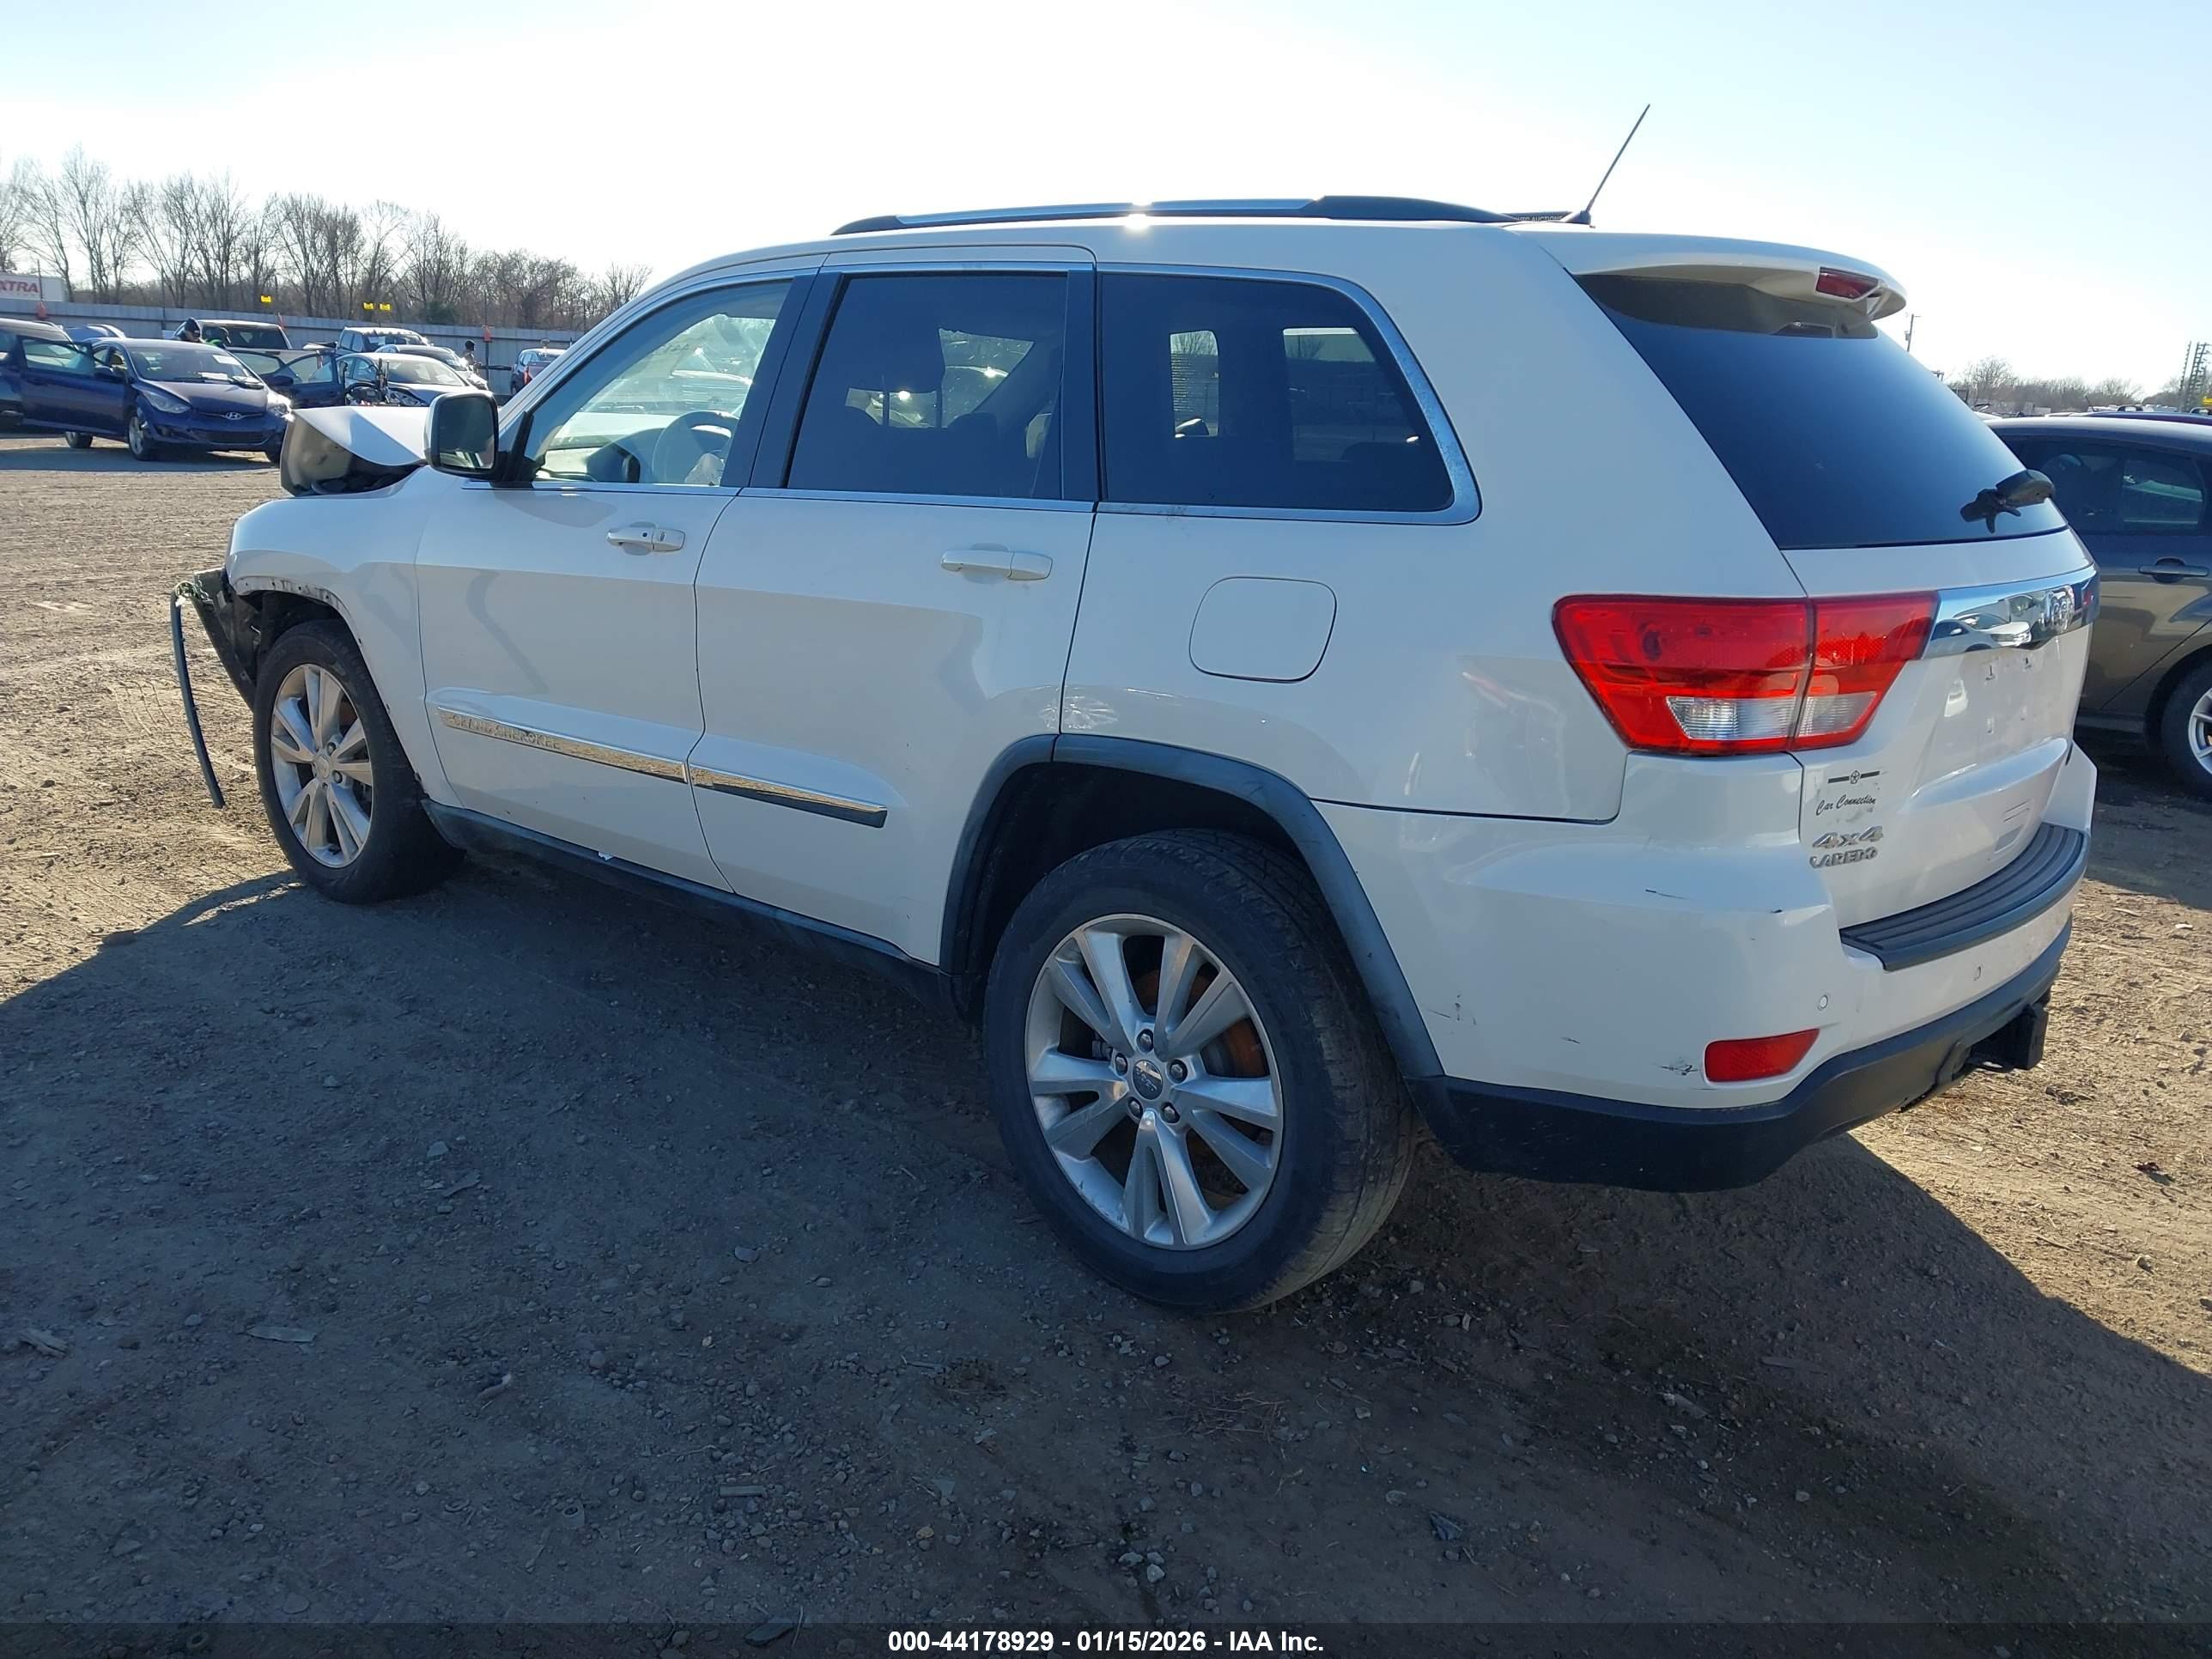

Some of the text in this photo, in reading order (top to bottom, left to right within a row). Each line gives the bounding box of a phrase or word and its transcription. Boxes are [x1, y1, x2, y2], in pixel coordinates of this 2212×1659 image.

[493, 725, 561, 750] CHEROKEE
[1815, 794, 1876, 816] Car Connection
